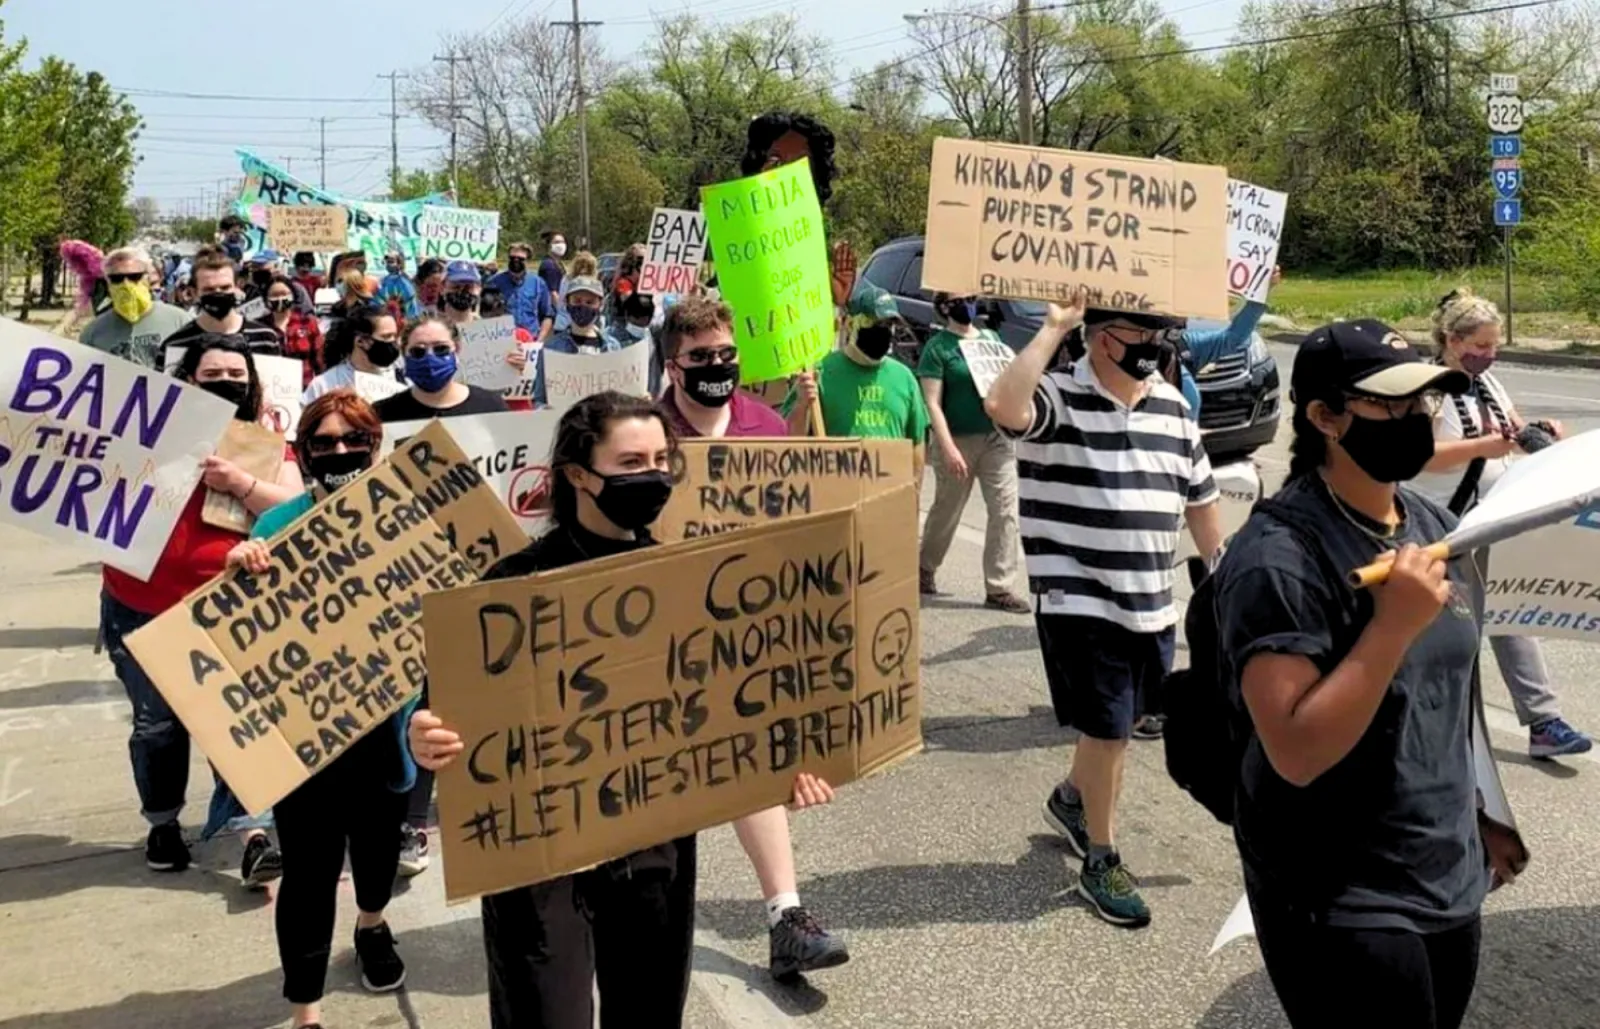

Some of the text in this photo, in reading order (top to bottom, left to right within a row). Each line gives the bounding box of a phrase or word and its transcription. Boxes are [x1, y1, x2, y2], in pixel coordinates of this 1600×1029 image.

[1493, 77, 1516, 89] WEST
[1491, 104, 1519, 125] 322
[1498, 141, 1513, 152] TO
[721, 176, 804, 219] MEDIA
[1085, 168, 1197, 212] STRAND
[1227, 182, 1270, 208] NTAL
[1497, 171, 1517, 189] 95
[424, 223, 486, 242] JUSTICE
[651, 212, 708, 243] BAN
[983, 196, 1141, 240] PUPPETS FOR
[426, 239, 495, 260] NOW
[650, 241, 699, 265] THE
[726, 217, 811, 264] BOROUGH
[991, 230, 1118, 272] COVANTA
[1239, 241, 1272, 266] SAY
[640, 263, 699, 292] BURN
[1227, 260, 1270, 298] O!!
[10, 347, 182, 449] BAN
[36, 426, 112, 461] THE
[708, 445, 891, 481] ENVIRONMENTAL
[368, 440, 449, 515] AIR
[697, 480, 811, 518] RACISM
[189, 462, 483, 685] A DUMPING GROUND
[301, 521, 458, 634] FOR PHILLY
[479, 584, 656, 676] DELCO
[229, 696, 287, 749] NEW
[289, 644, 357, 705] YORK
[368, 592, 423, 642] NEW
[558, 601, 856, 710] IS IGNORING
[222, 640, 311, 714] DELCO
[310, 648, 391, 721] OCEAN
[296, 709, 362, 767] BAN
[356, 674, 405, 717] THE
[467, 648, 855, 785] CHESTER'S CRIES
